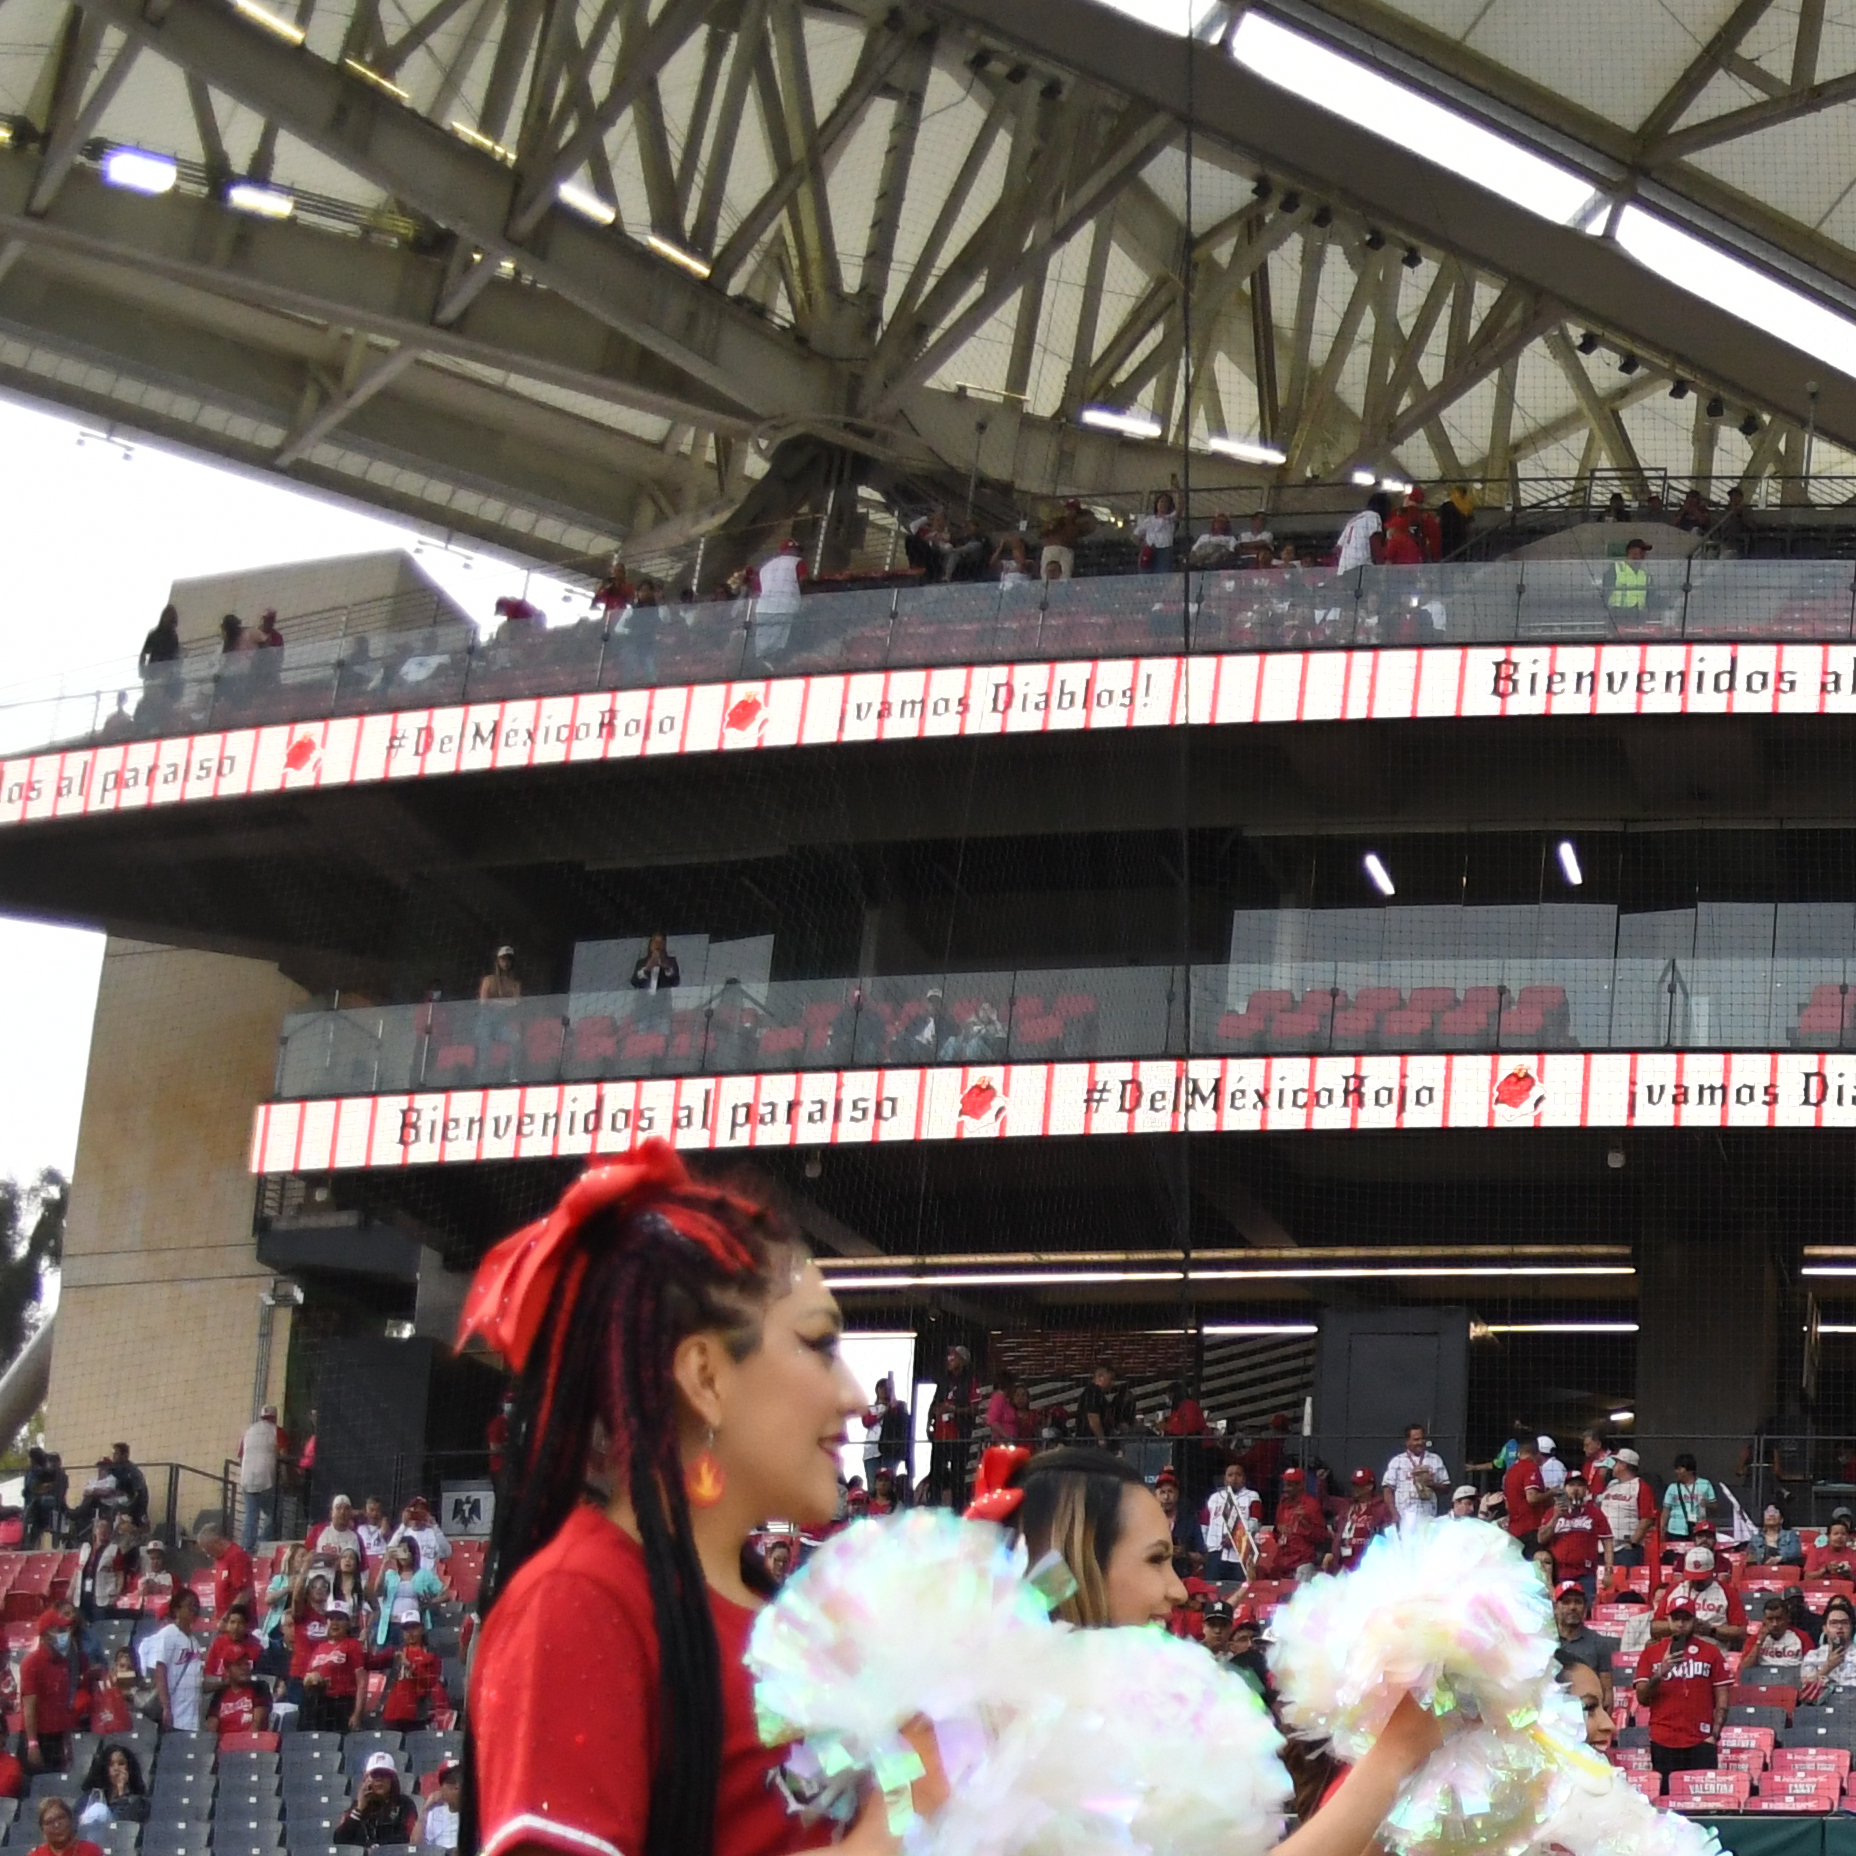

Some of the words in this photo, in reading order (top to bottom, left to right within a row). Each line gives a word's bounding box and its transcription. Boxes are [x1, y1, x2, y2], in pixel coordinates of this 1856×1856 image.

[990, 673, 1154, 716] Diablos!
[1491, 656, 1798, 699] Bienvenidos
[397, 1096, 658, 1148] Bienvenidos
[674, 1088, 712, 1132] al
[1083, 1073, 1436, 1120] #DelMéxicoRojo
